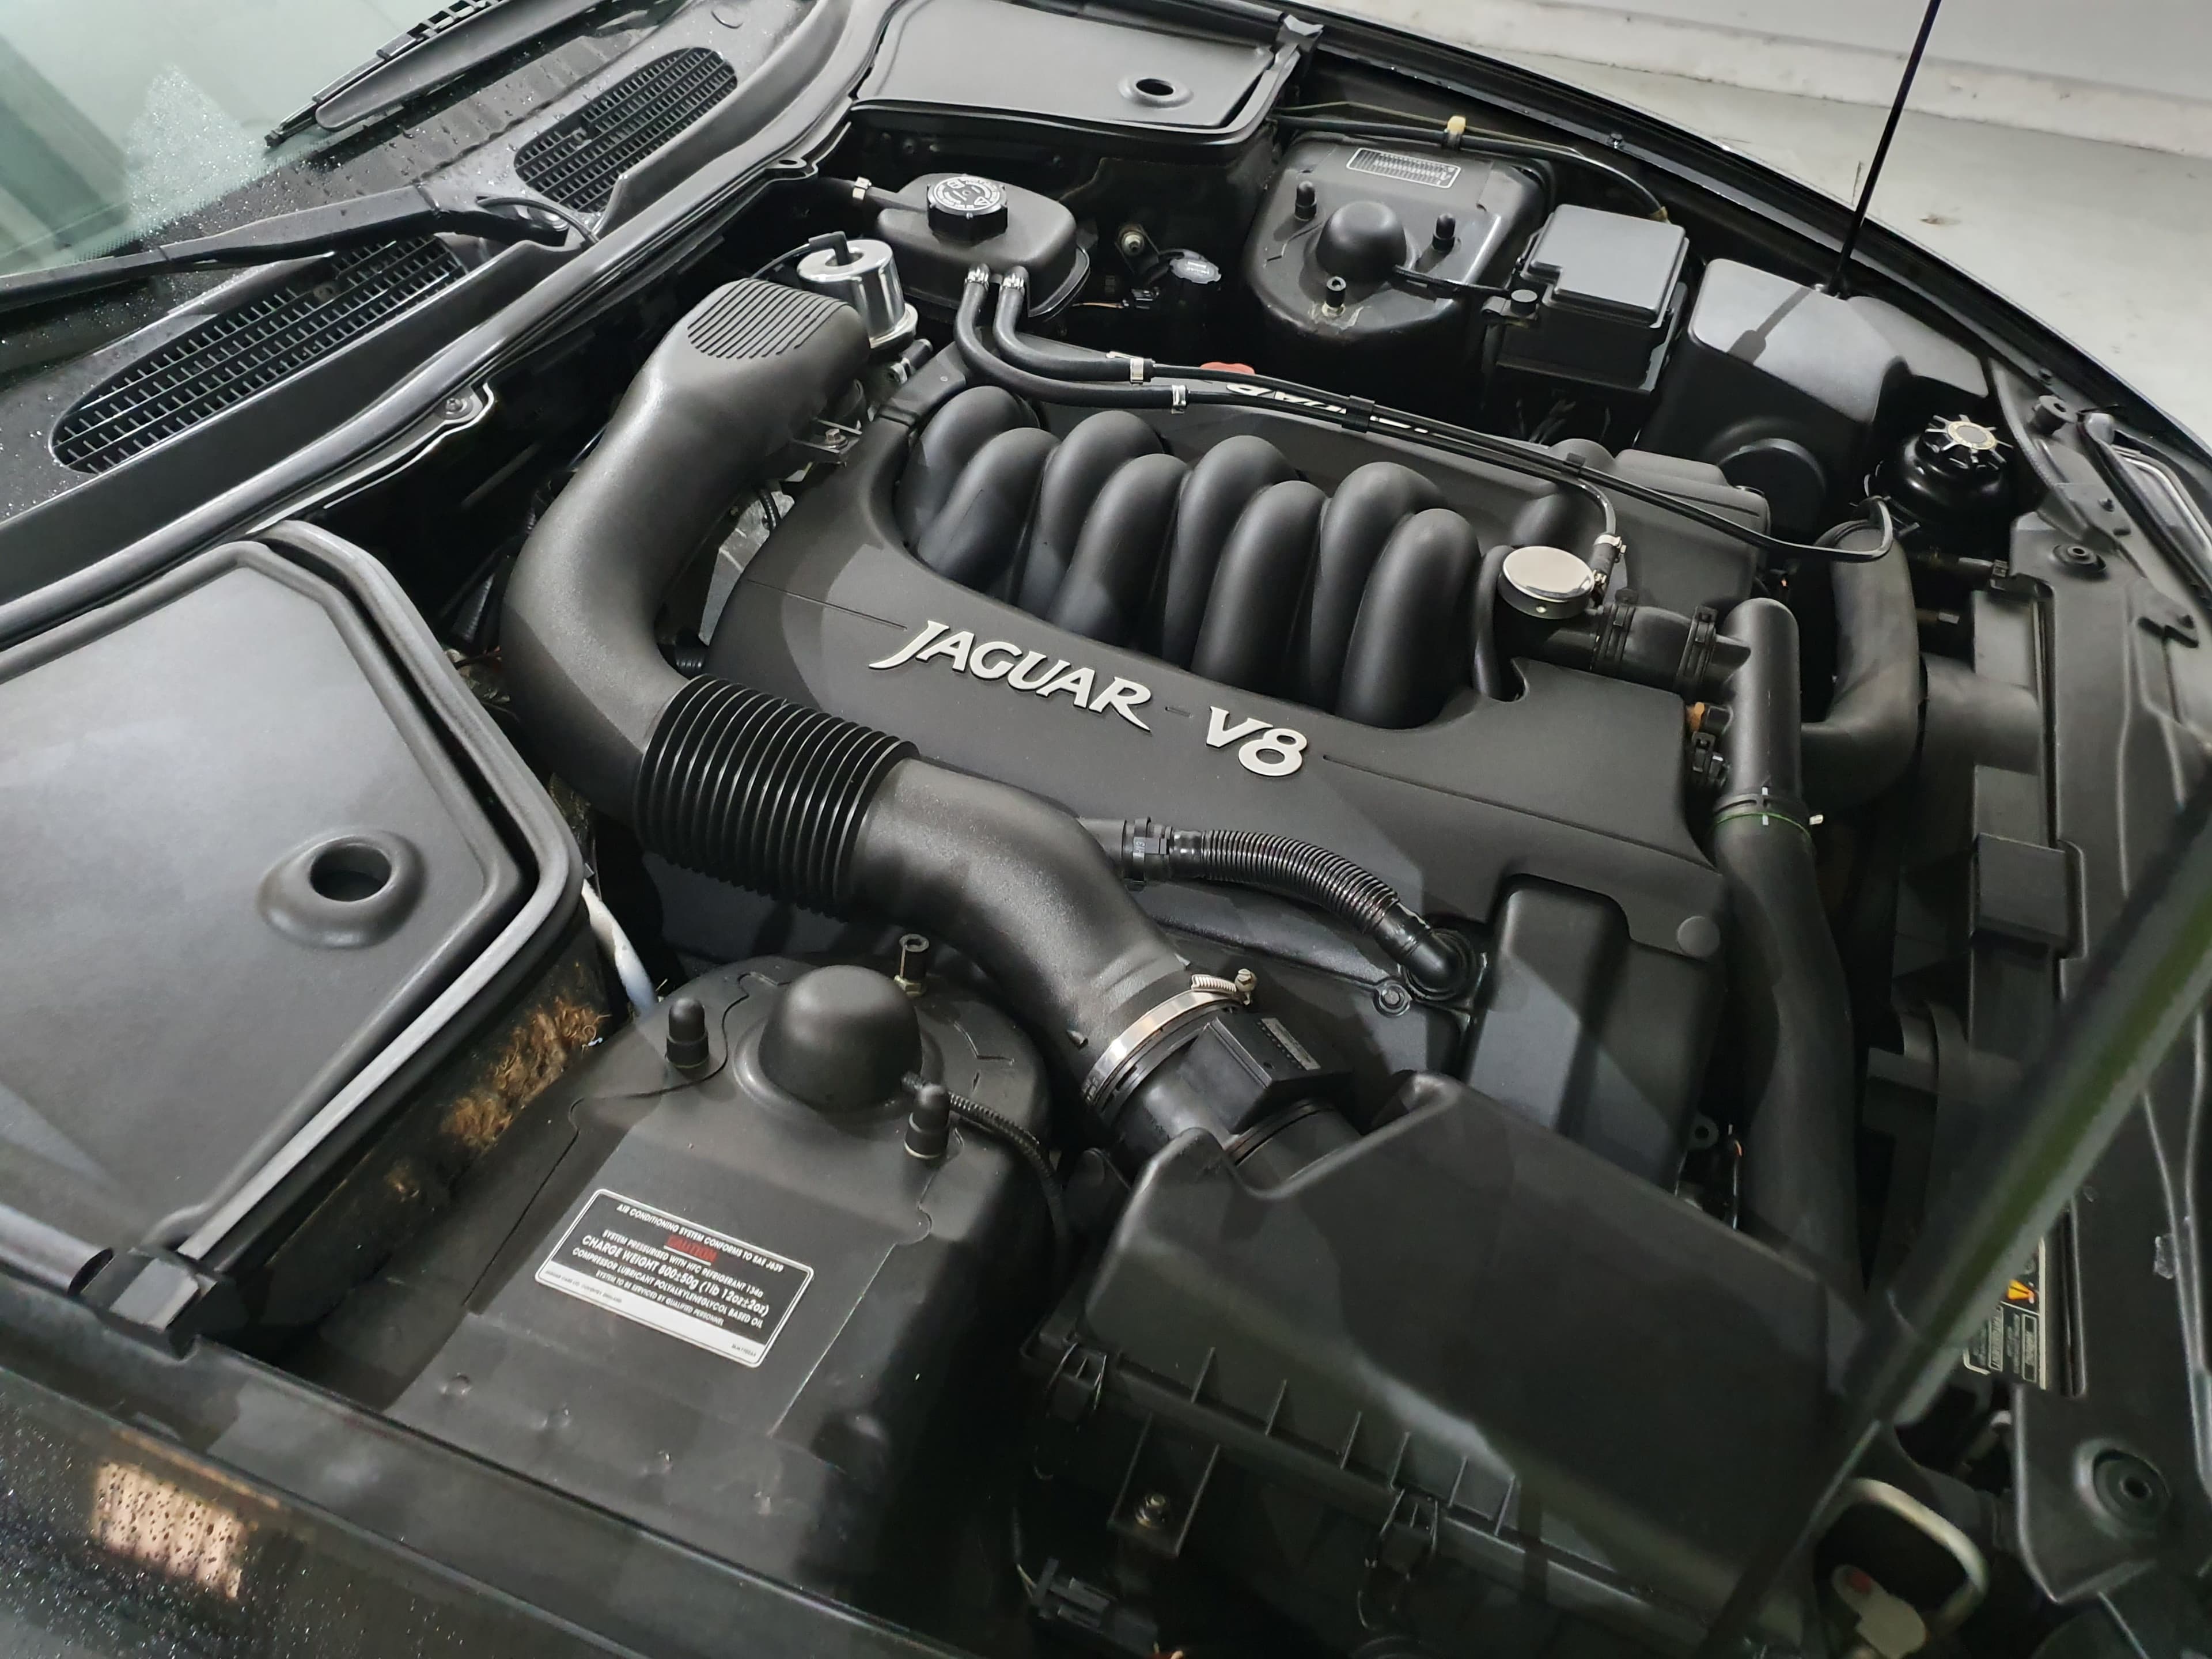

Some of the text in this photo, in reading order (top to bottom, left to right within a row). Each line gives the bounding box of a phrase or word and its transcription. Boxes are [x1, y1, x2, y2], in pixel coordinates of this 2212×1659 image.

[868, 620, 1308, 777] JAGUAR V8
[582, 1234, 623, 1257] CHARGE
[622, 1249, 660, 1271] WEIGHT
[658, 1264, 699, 1290] 800±50g
[698, 1281, 719, 1296] (1lb
[602, 1229, 628, 1245] SYSTEM
[626, 1238, 669, 1260] PRESSURISED
[669, 1255, 687, 1267] WITH
[685, 1262, 702, 1273] HFC
[701, 1267, 746, 1290] REFRIGERANT
[616, 1203, 783, 1272] AIR CONDITIONING SYSTEM CONFORMS TO SAE J639
[572, 1247, 618, 1270] COMPRESSOR
[616, 1264, 655, 1285] LUBRICANT
[728, 1308, 751, 1323] BASED
[751, 1317, 763, 1328] OIL
[595, 1269, 616, 1283] SYSTEM
[615, 1277, 624, 1286] TO
[631, 1283, 657, 1299] SERVICED
[657, 1294, 666, 1302] BY
[665, 1297, 693, 1313] QUALIFIED
[692, 1308, 724, 1326] PERSONNEL
